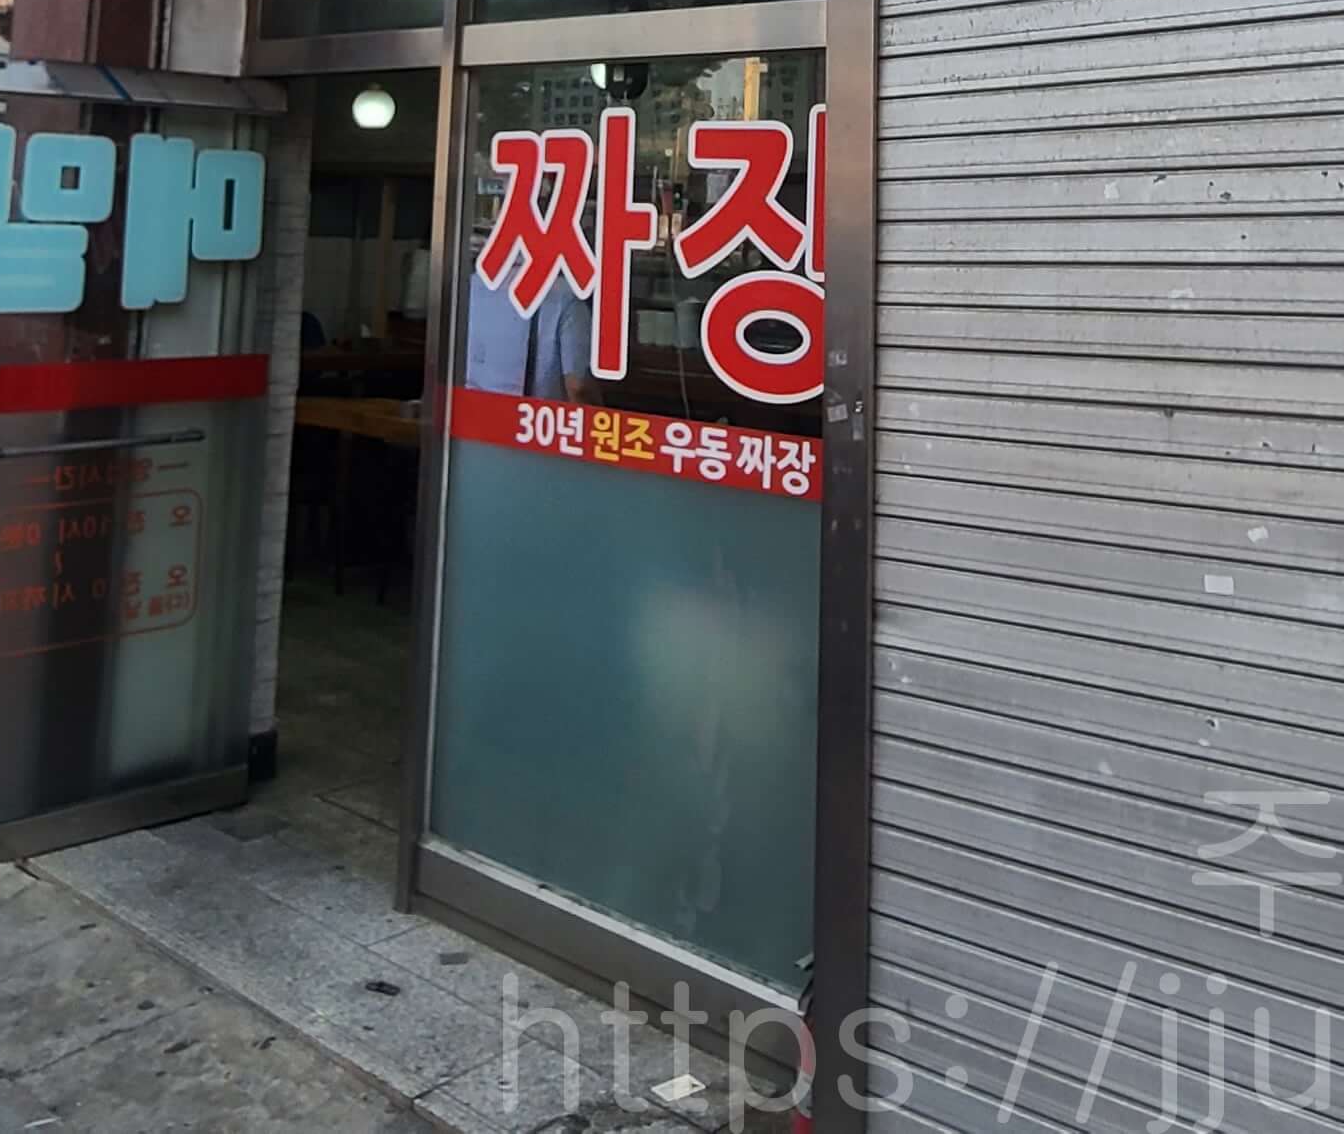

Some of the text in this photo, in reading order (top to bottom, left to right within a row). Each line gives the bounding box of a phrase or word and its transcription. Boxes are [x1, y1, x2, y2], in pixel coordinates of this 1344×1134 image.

[515, 403, 816, 497] 30년 원조 우동 짜장
